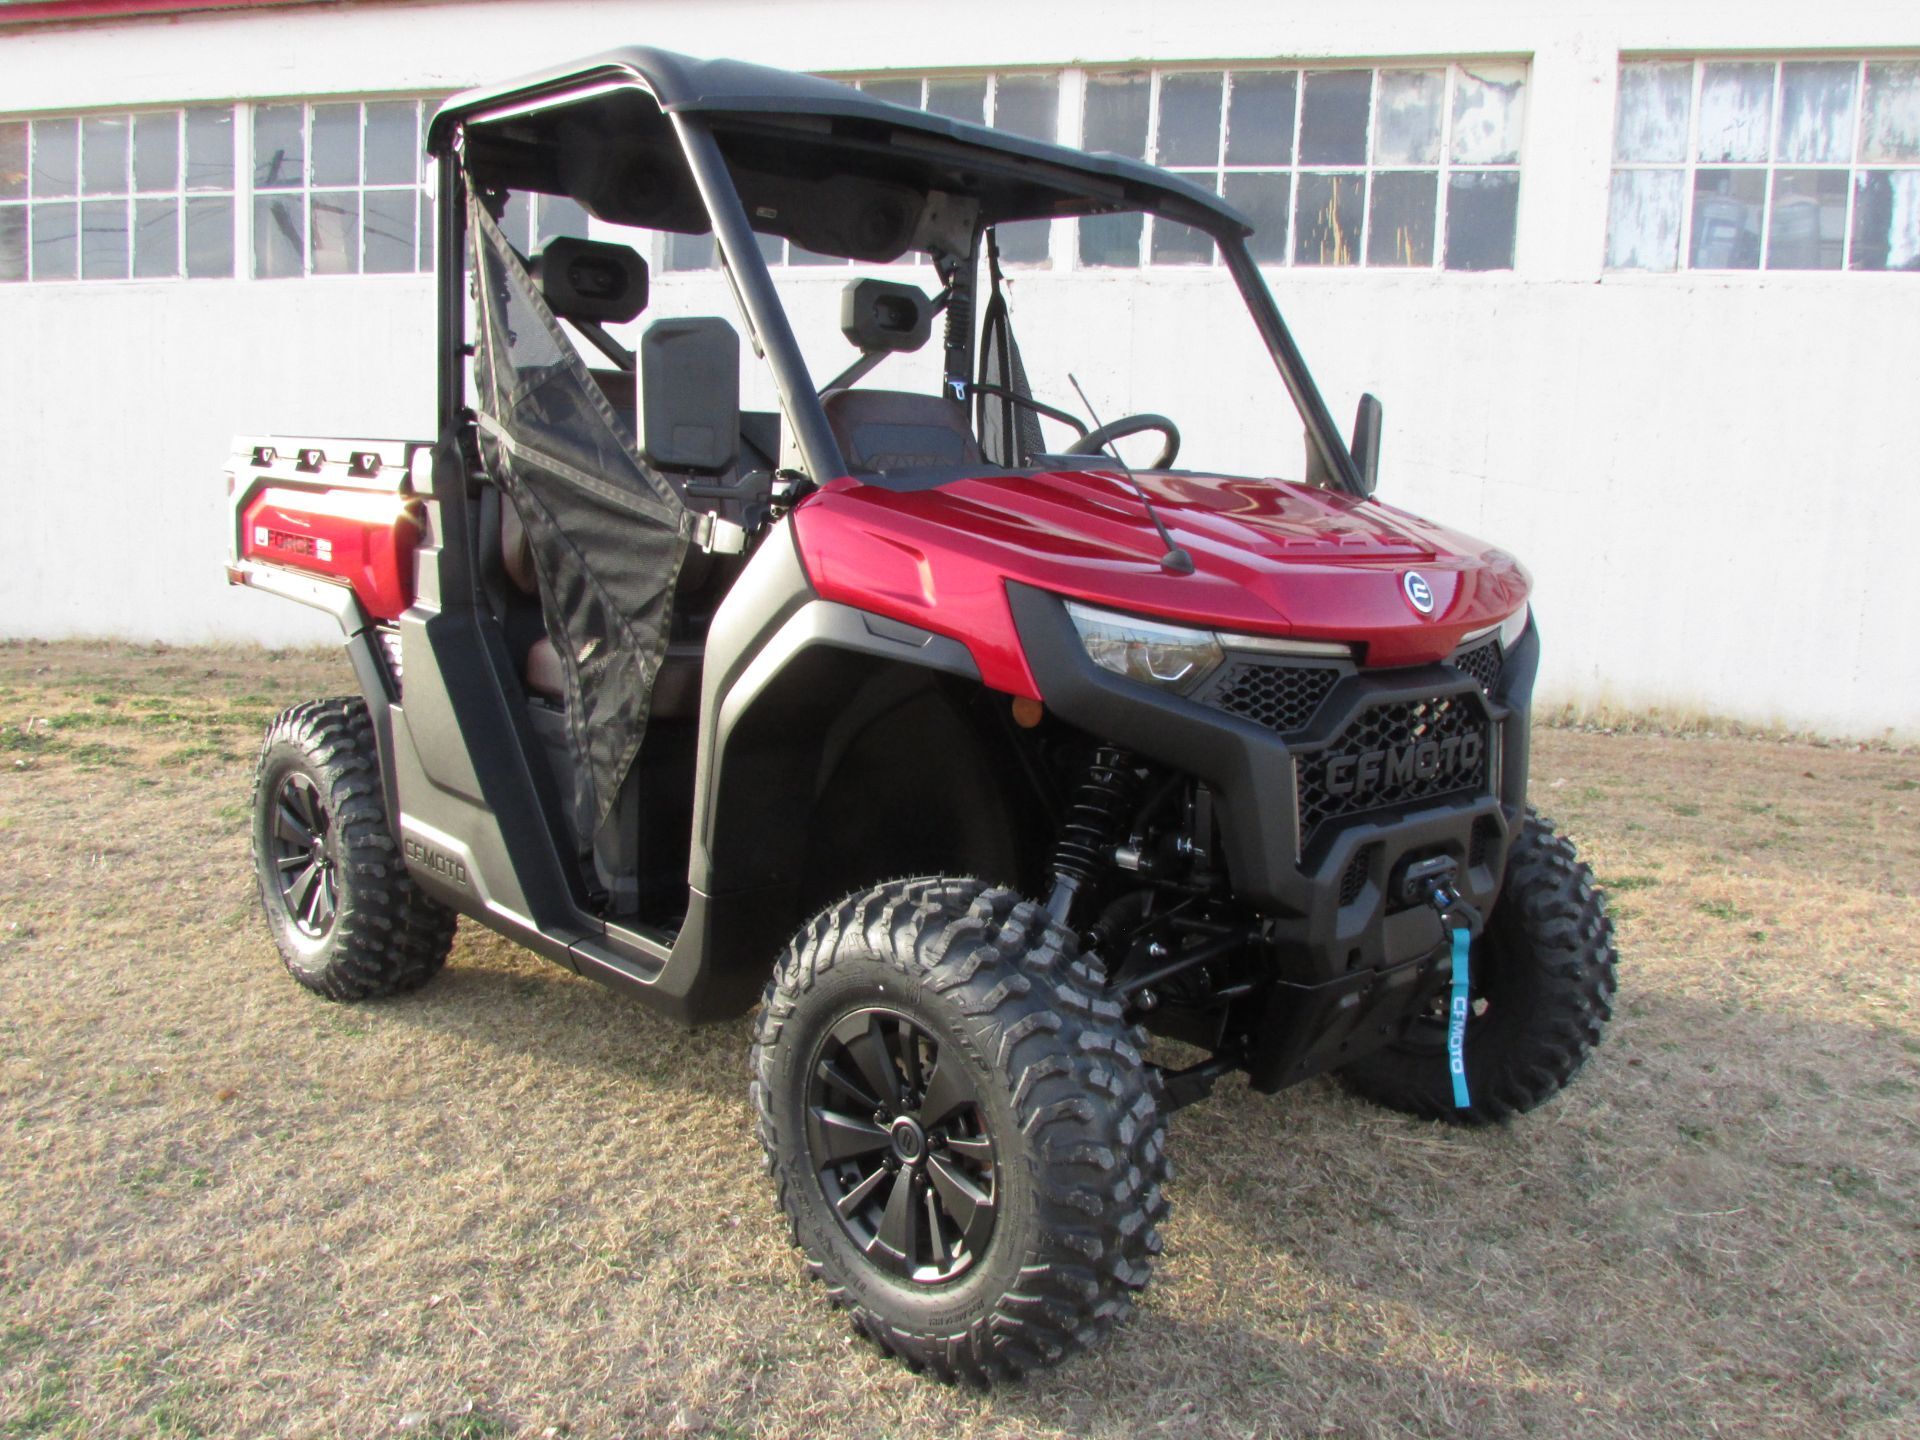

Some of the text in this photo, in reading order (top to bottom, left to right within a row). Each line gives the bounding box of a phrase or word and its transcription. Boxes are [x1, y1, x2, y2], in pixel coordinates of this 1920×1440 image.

[1326, 732, 1482, 794] CFMOTO
[405, 838, 466, 884] CFMOTO
[1450, 997, 1467, 1074] CFMOTO
